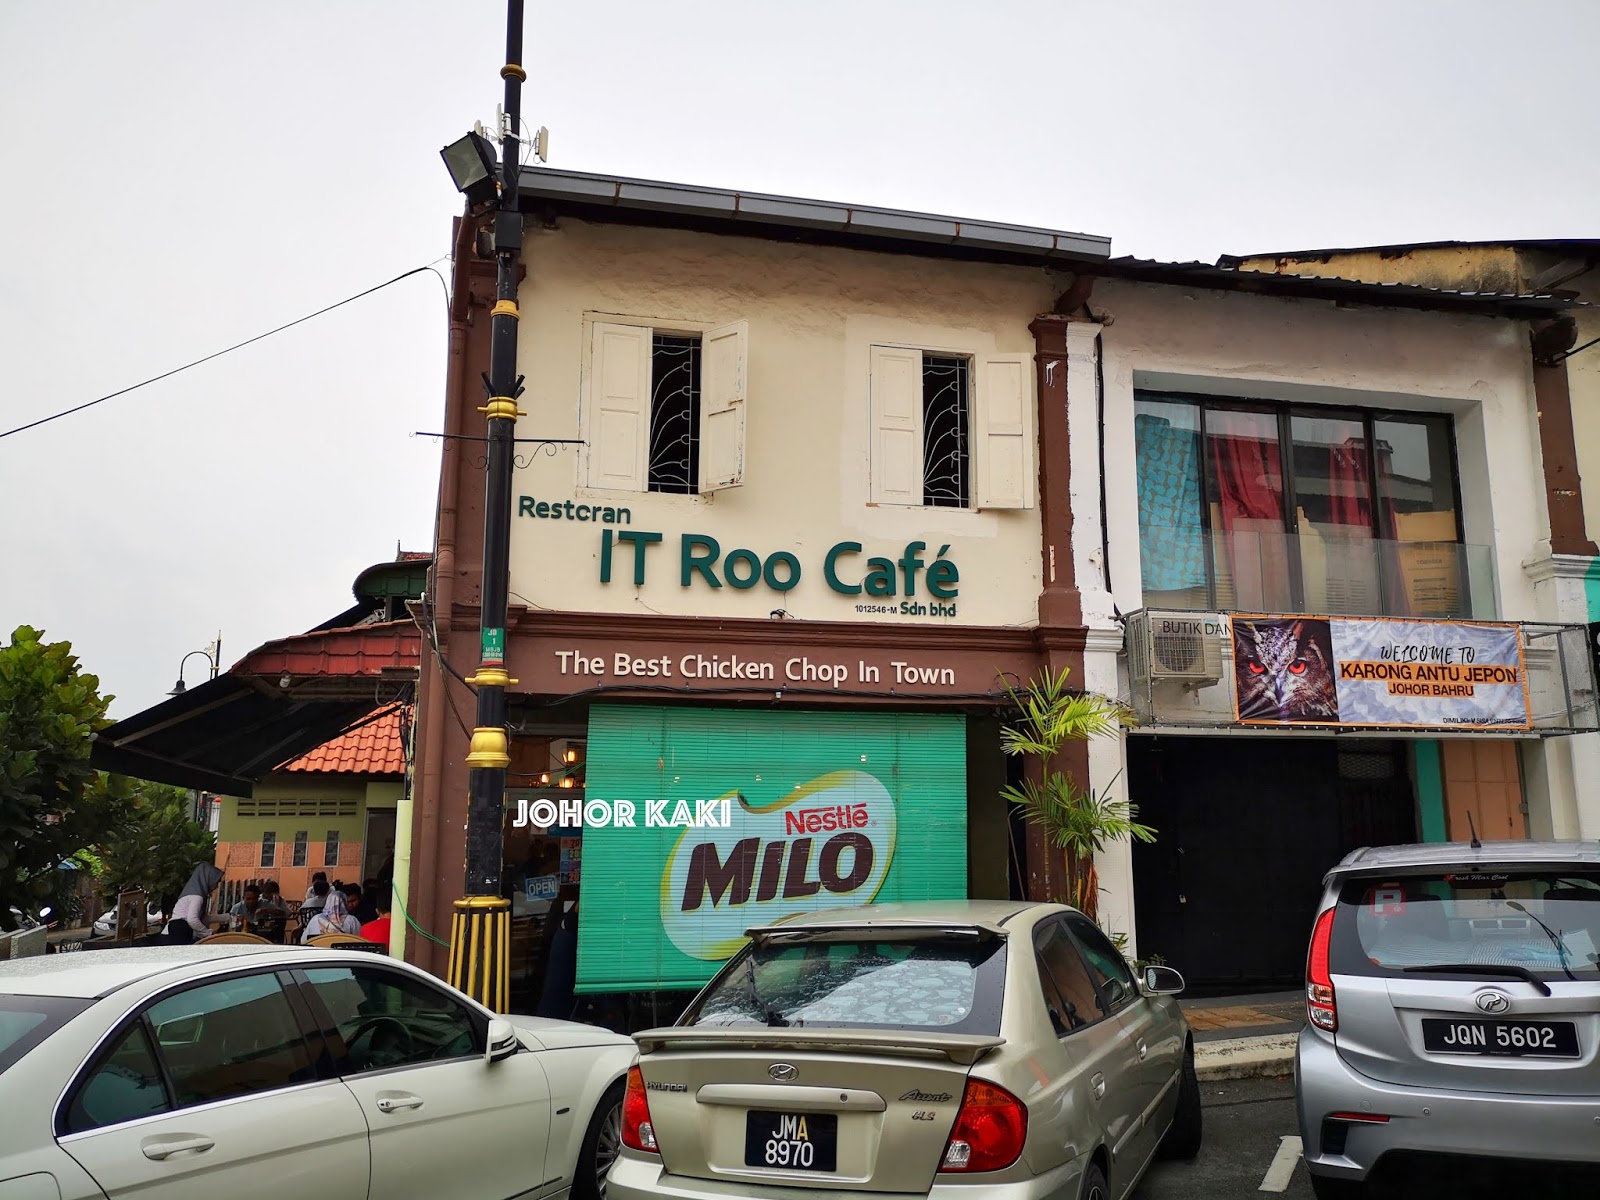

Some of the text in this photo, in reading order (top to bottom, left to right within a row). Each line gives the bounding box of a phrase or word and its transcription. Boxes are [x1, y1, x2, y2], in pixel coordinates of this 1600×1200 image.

[519, 495, 631, 525] Restoran
[600, 528, 960, 598] IT Roo Café
[854, 601, 957, 617] 1012546-M Sdn bhd
[1162, 620, 1202, 635] BUTIK
[1380, 641, 1475, 666] WELCOME TO
[555, 650, 956, 688] The Best Chicken Chop In Town
[1340, 662, 1517, 683] KARONG ANTU JEPON
[1389, 683, 1474, 697] JOHOR BAHRU
[785, 803, 868, 836] Nestlé
[681, 831, 874, 912] MILO
[528, 881, 555, 896] OPEN
[1443, 1024, 1557, 1048] JQN 5602
[898, 1089, 953, 1102] Accent
[772, 1115, 808, 1140] JMA
[912, 1110, 936, 1121] GLS
[765, 1139, 814, 1167] 8970
